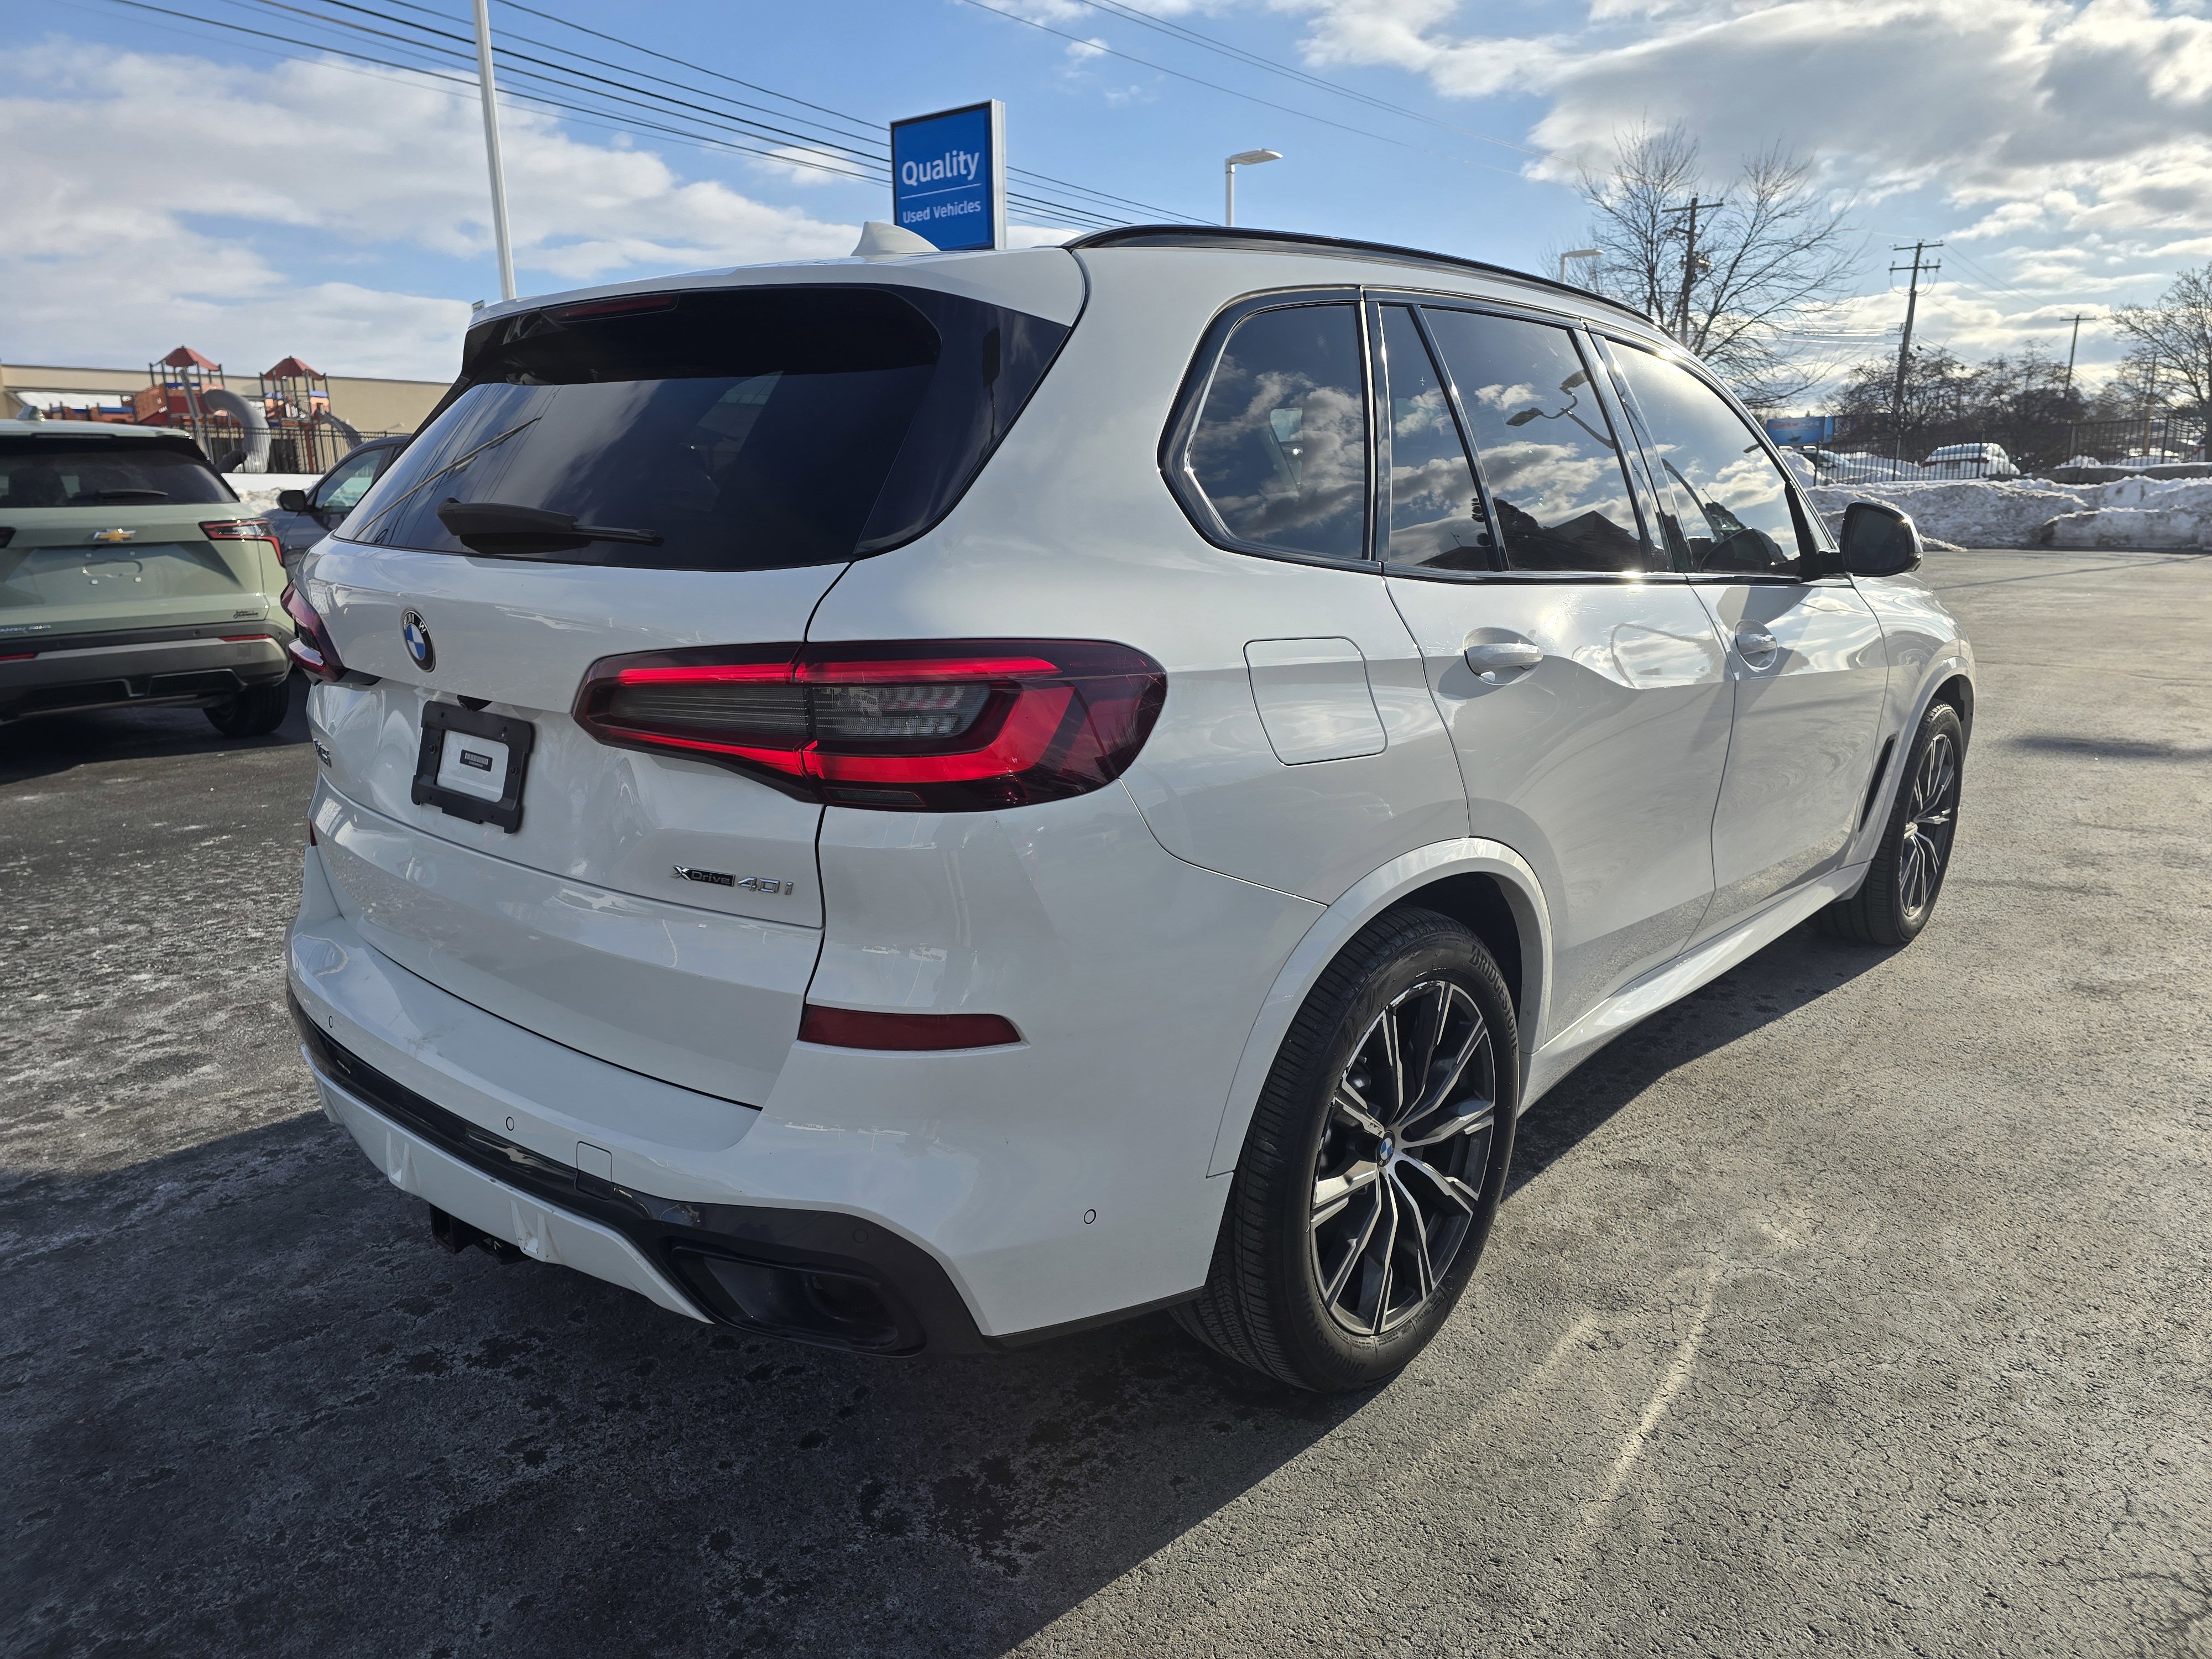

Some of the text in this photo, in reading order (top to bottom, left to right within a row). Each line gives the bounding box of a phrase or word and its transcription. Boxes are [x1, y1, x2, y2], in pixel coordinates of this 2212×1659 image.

[901, 150, 979, 186] Quality
[902, 200, 981, 223] Used Vehicles
[1468, 943, 1518, 1057] BRIDGESTONE
